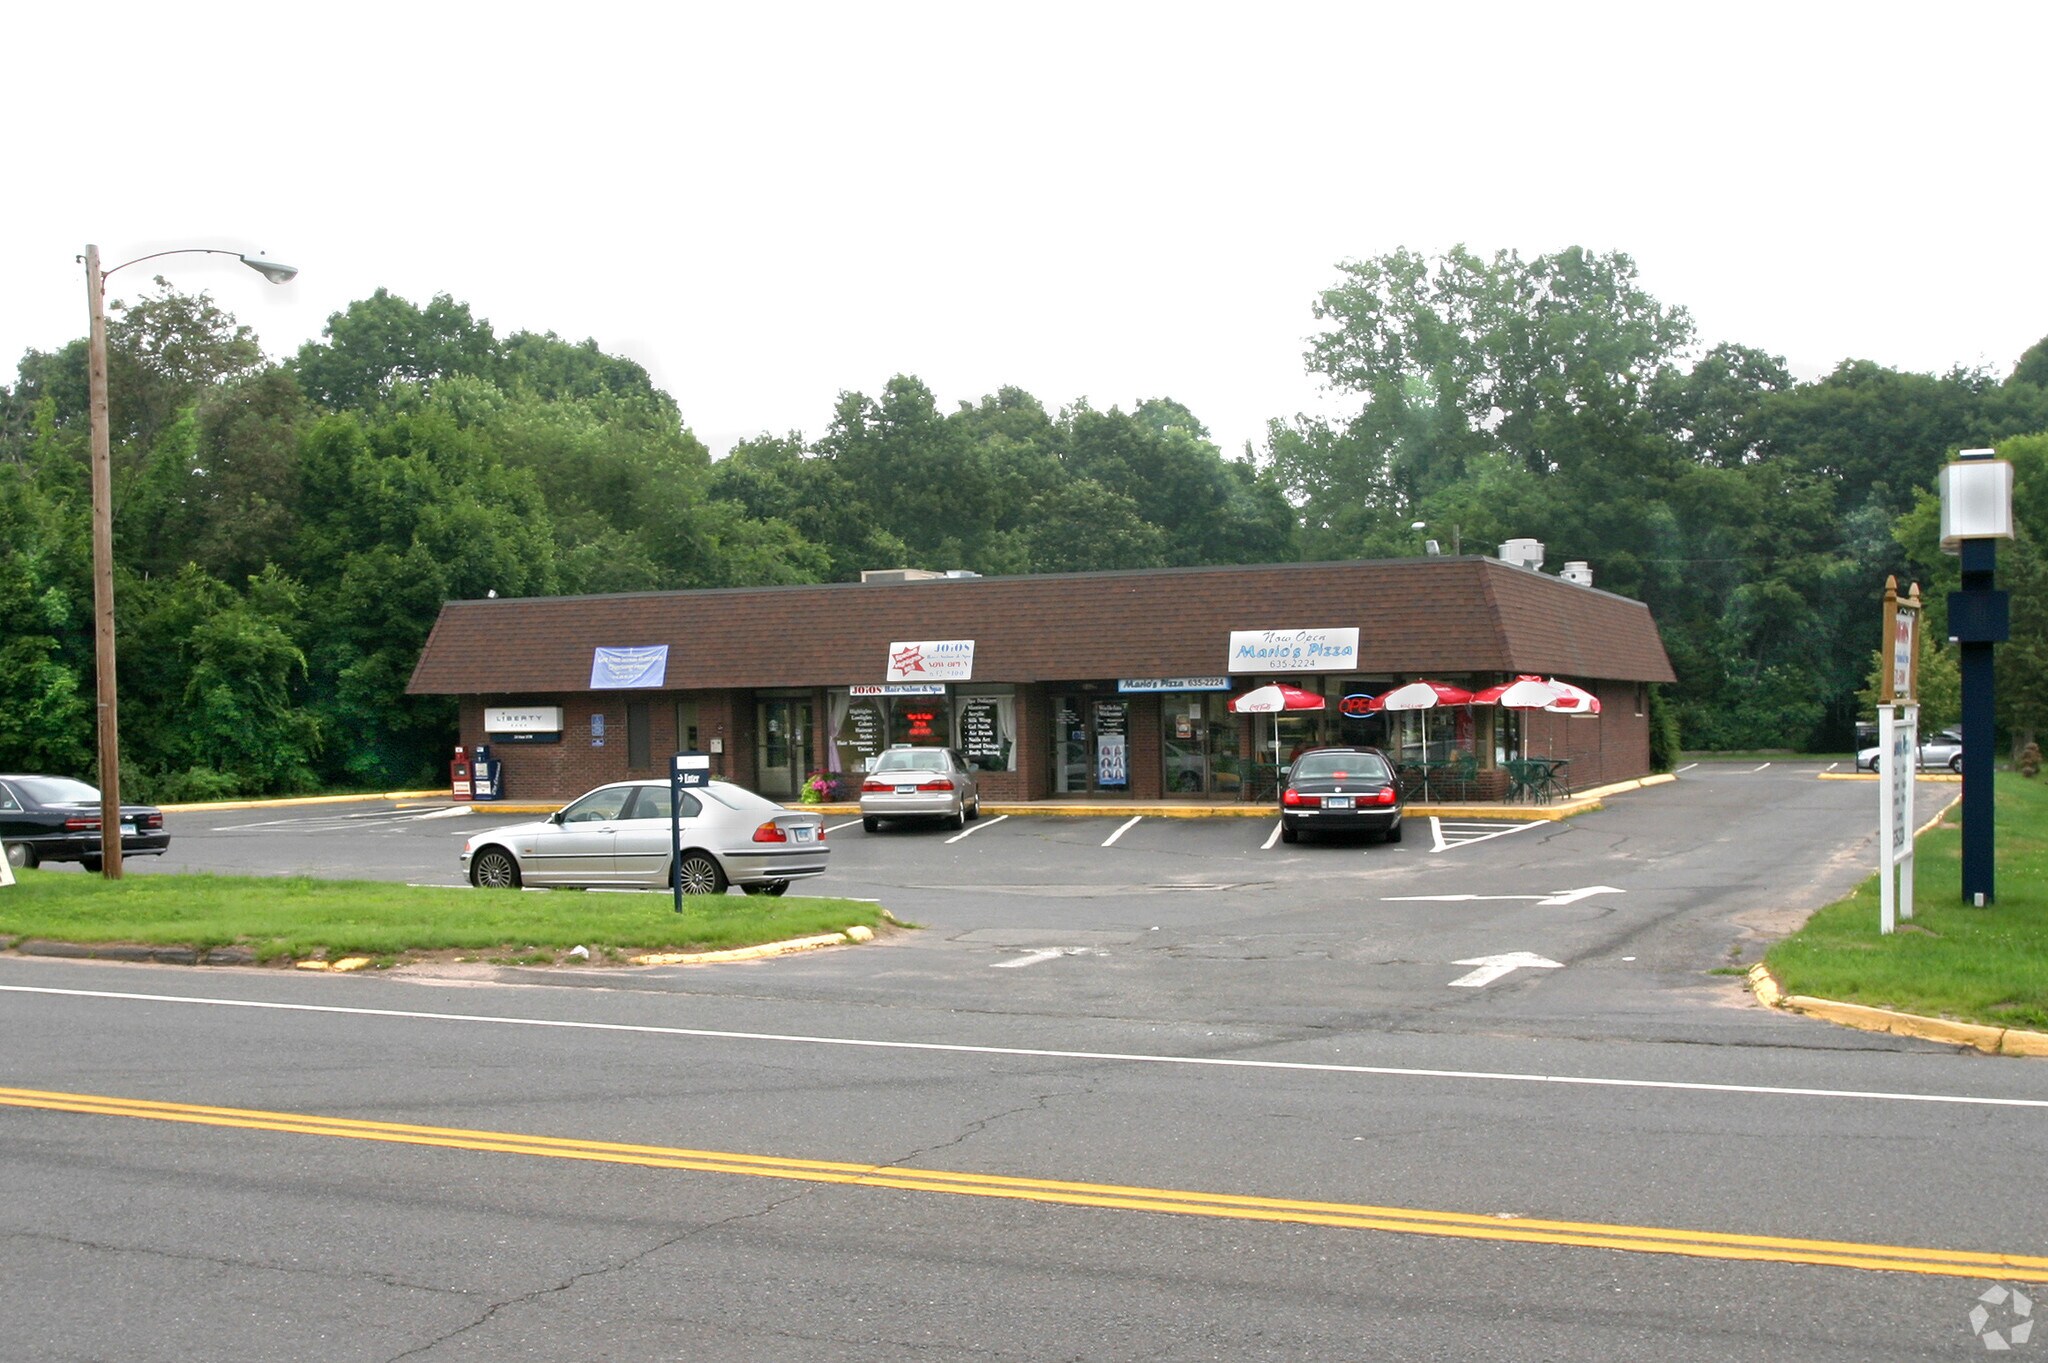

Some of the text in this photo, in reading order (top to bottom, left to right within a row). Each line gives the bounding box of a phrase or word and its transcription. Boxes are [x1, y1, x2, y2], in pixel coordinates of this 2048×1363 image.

[1262, 631, 1327, 644] Now Open
[1236, 643, 1353, 658] Mario's Pizza
[1269, 659, 1316, 668] 635-2224
[1123, 678, 1224, 689] Mario's Pizza 635-2224
[884, 685, 900, 693] Hair
[901, 685, 921, 693] Salon
[929, 685, 942, 694] Spa
[1339, 699, 1370, 713] OPE
[684, 773, 701, 784] Enter
